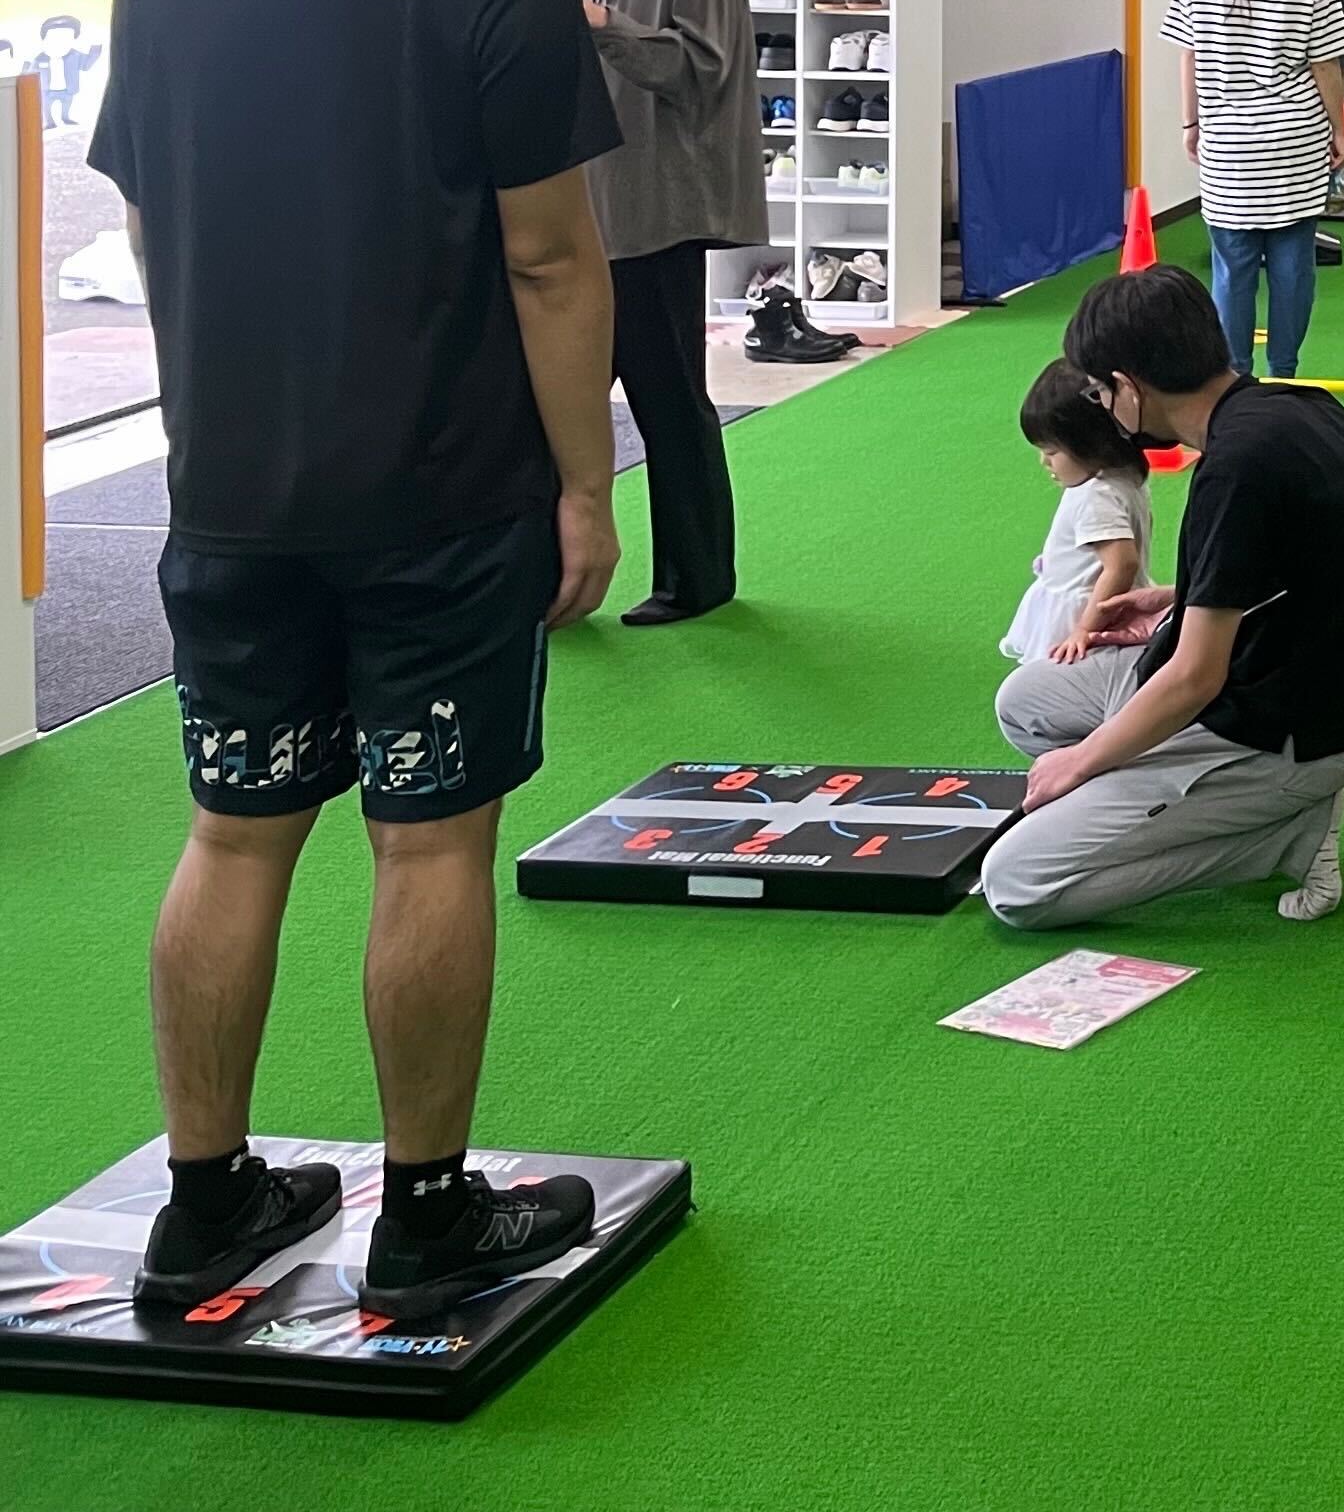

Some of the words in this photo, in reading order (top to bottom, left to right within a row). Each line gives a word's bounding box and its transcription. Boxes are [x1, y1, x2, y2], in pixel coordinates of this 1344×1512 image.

[176, 684, 467, 795] huel
[713, 771, 759, 791] 6
[816, 773, 863, 794] 5
[924, 777, 970, 797] 4
[624, 829, 673, 850] 3
[733, 833, 785, 854] 2
[851, 836, 890, 857] 1
[647, 851, 701, 863] Mat
[697, 852, 832, 867] Functional
[462, 1154, 522, 1173] Mat
